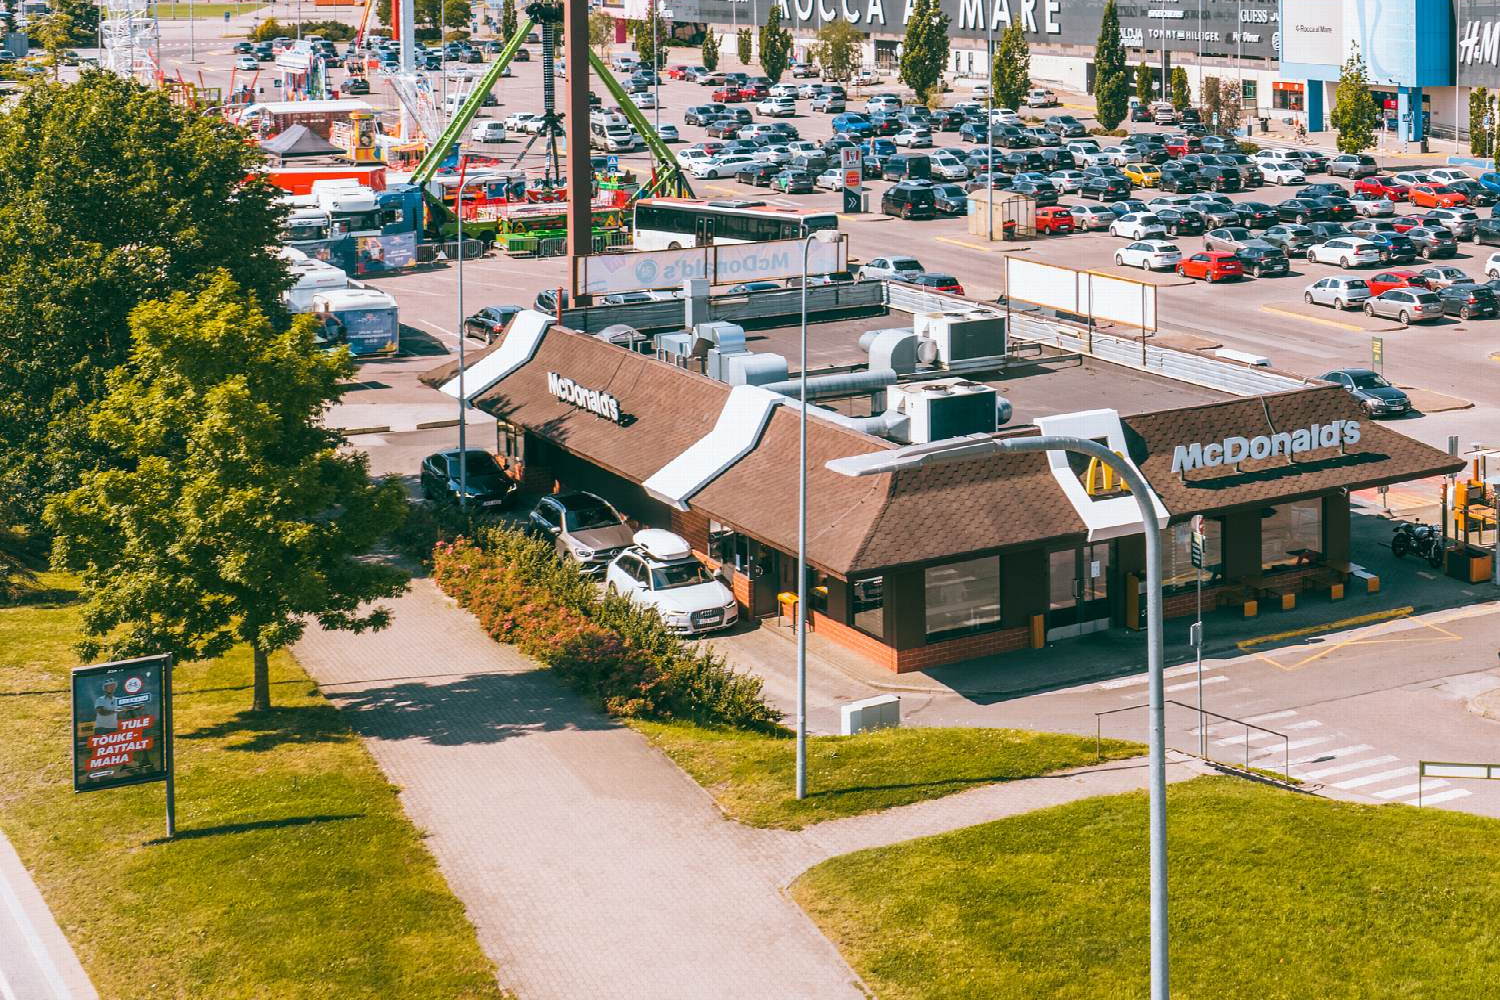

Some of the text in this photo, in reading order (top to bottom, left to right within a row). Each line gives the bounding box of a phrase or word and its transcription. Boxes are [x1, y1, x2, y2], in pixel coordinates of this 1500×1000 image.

[1240, 9, 1267, 23] GUESS
[1148, 28, 1220, 42] TOMMY HILFIGER
[547, 371, 619, 421] McDonald's
[1172, 419, 1361, 472] McDonald's
[121, 717, 150, 730] TULE
[97, 740, 149, 757] RATTALT
[90, 753, 129, 768] MAHA
